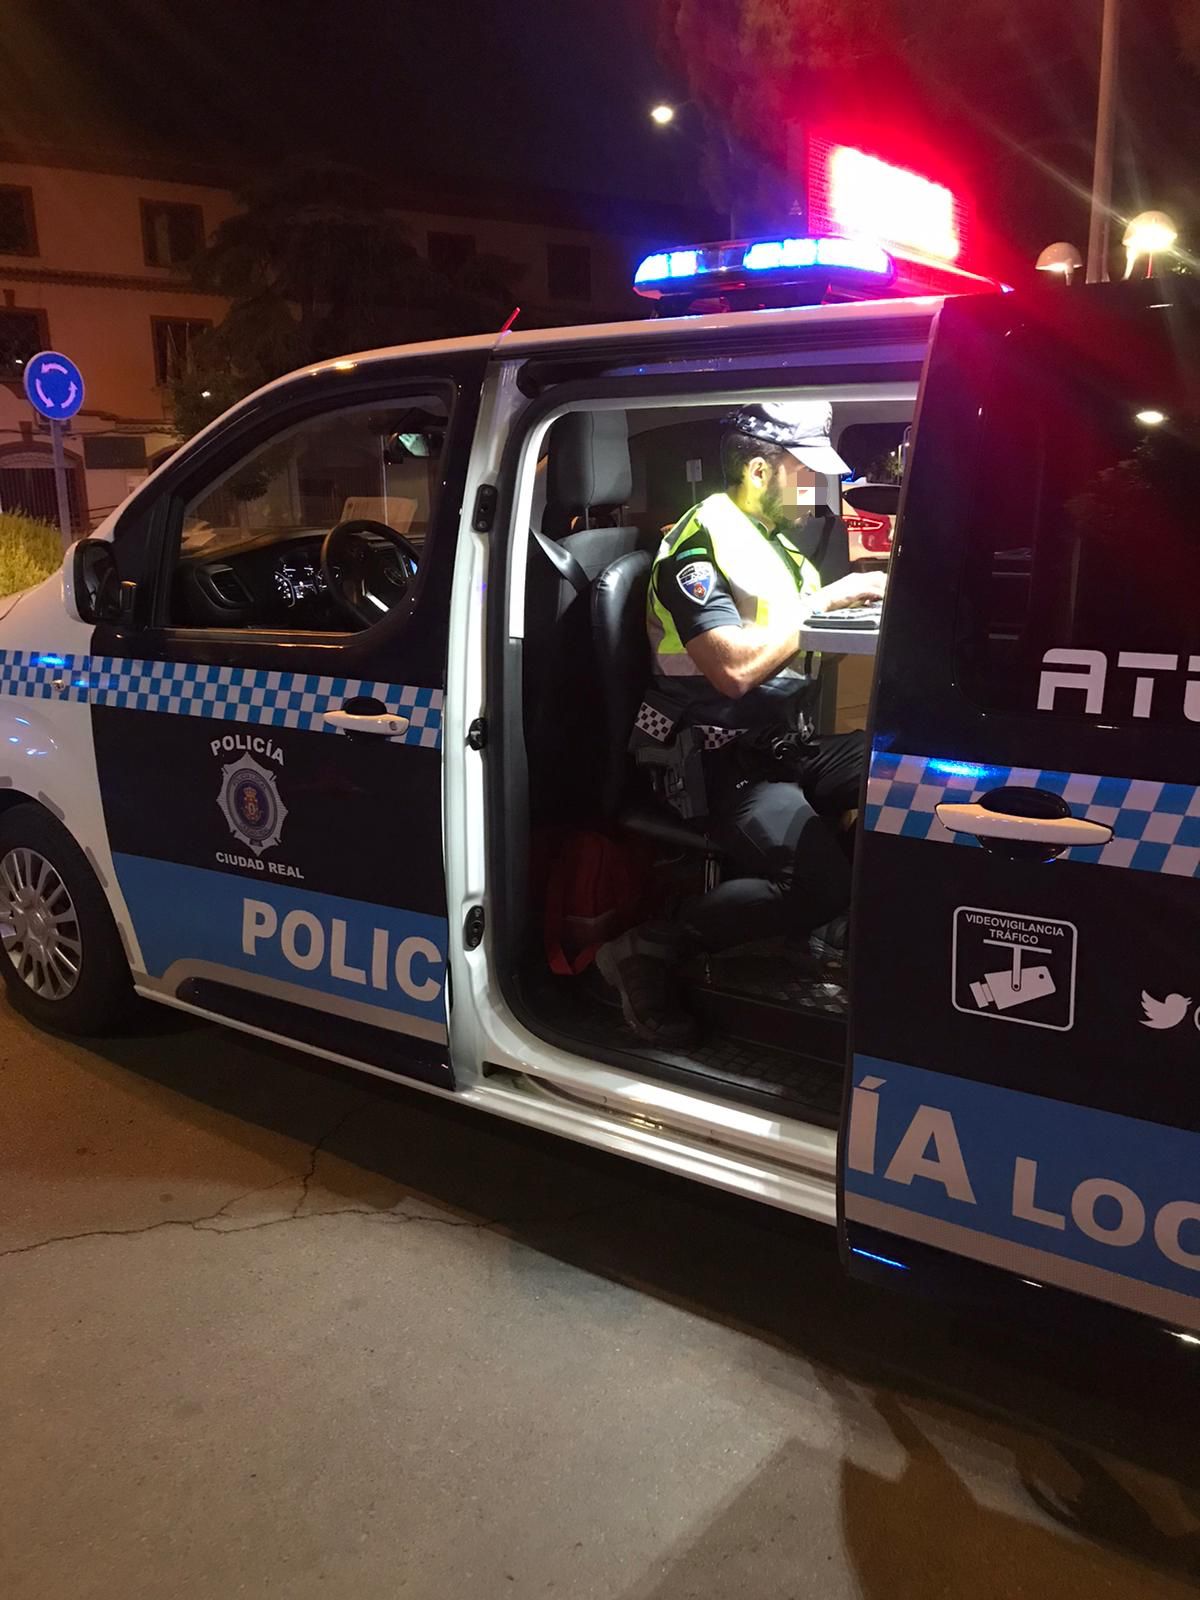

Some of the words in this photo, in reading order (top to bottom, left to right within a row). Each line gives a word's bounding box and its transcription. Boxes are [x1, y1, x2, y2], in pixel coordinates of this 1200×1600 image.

[1037, 648, 1200, 722] AT
[210, 735, 284, 766] POLICÍA
[215, 852, 265, 871] CIUDAD
[268, 862, 305, 879] REAL
[965, 913, 1065, 937] VIDEOVIGILANCIA
[989, 928, 1039, 944] TRÁFICO
[242, 898, 442, 1002] POLIC
[847, 1075, 977, 1205] ÍA
